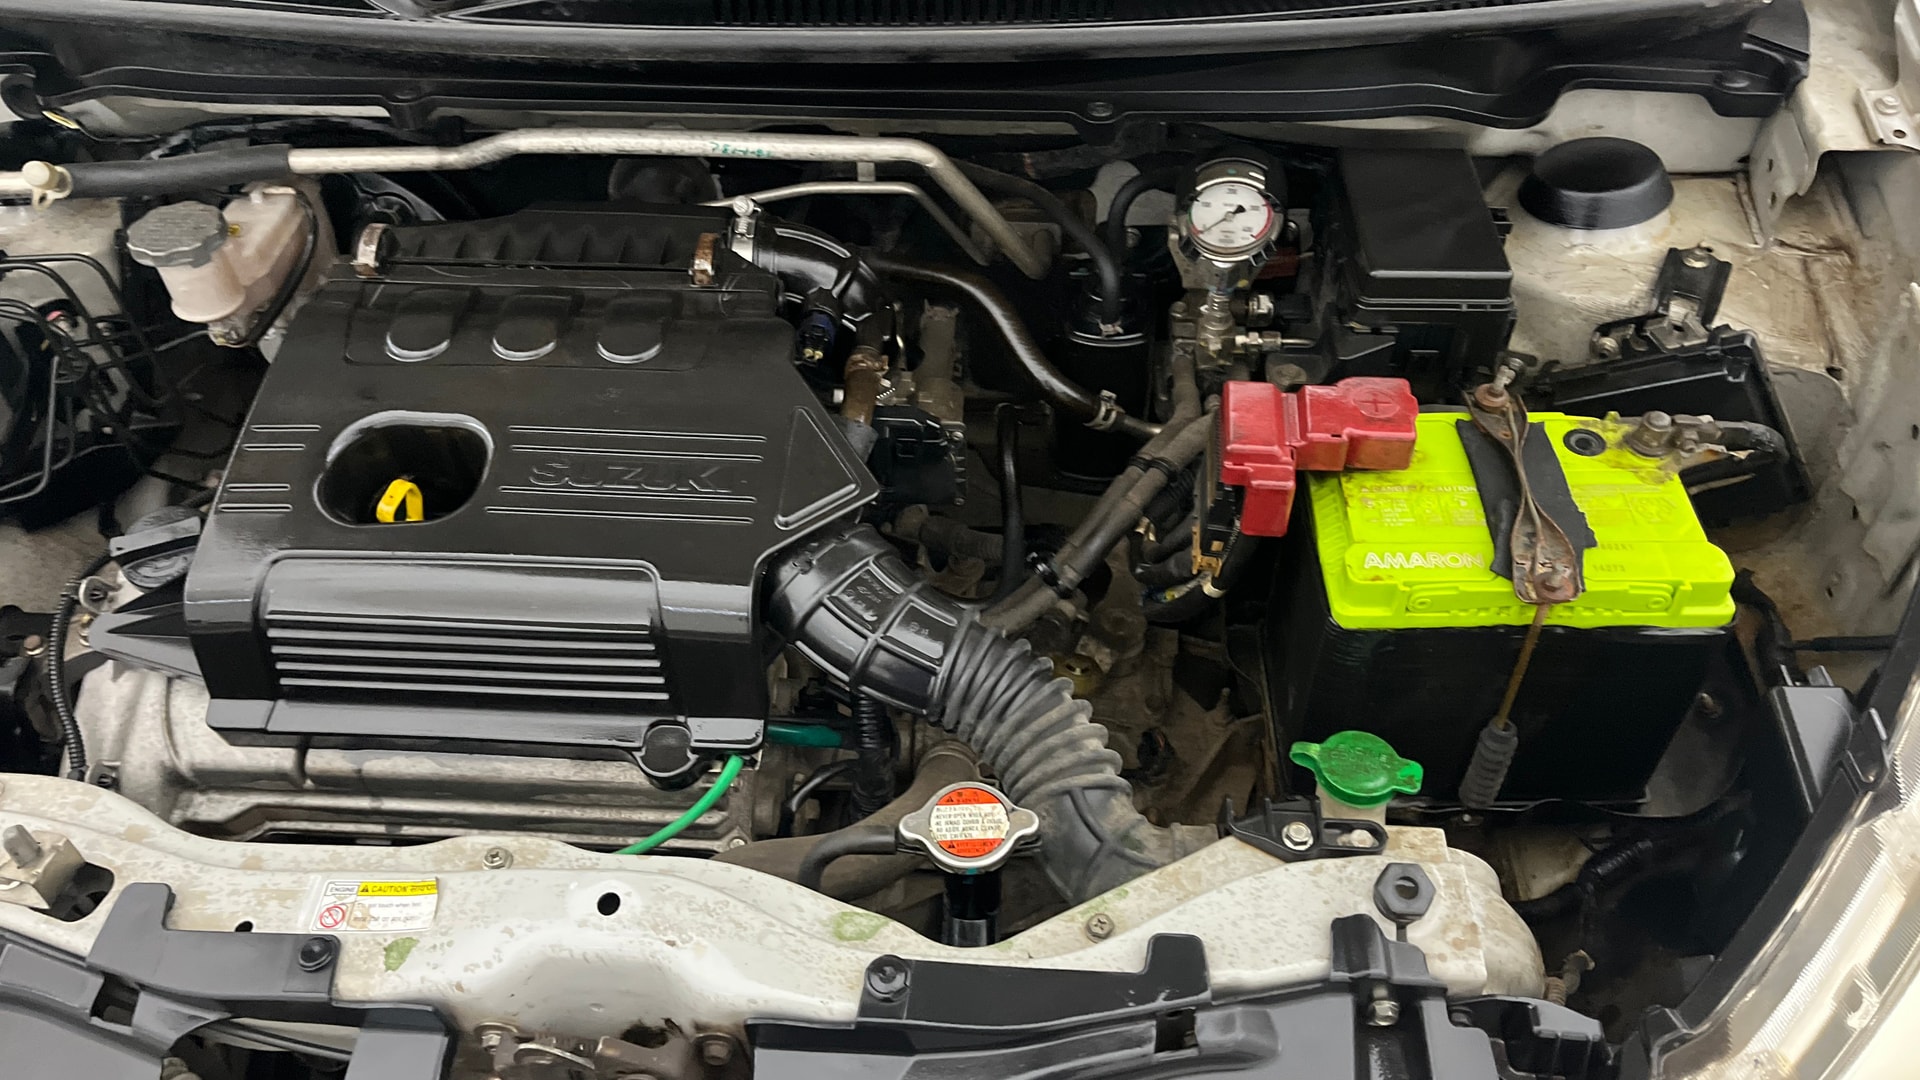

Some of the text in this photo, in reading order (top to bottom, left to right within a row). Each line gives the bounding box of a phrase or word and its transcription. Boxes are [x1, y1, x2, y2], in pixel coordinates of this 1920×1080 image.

[528, 461, 749, 494] SUZUK
[1428, 484, 1478, 493] CAUTION
[1363, 551, 1485, 569] AMARON
[329, 885, 356, 893] ENGINE
[371, 885, 408, 893] CAUTION
